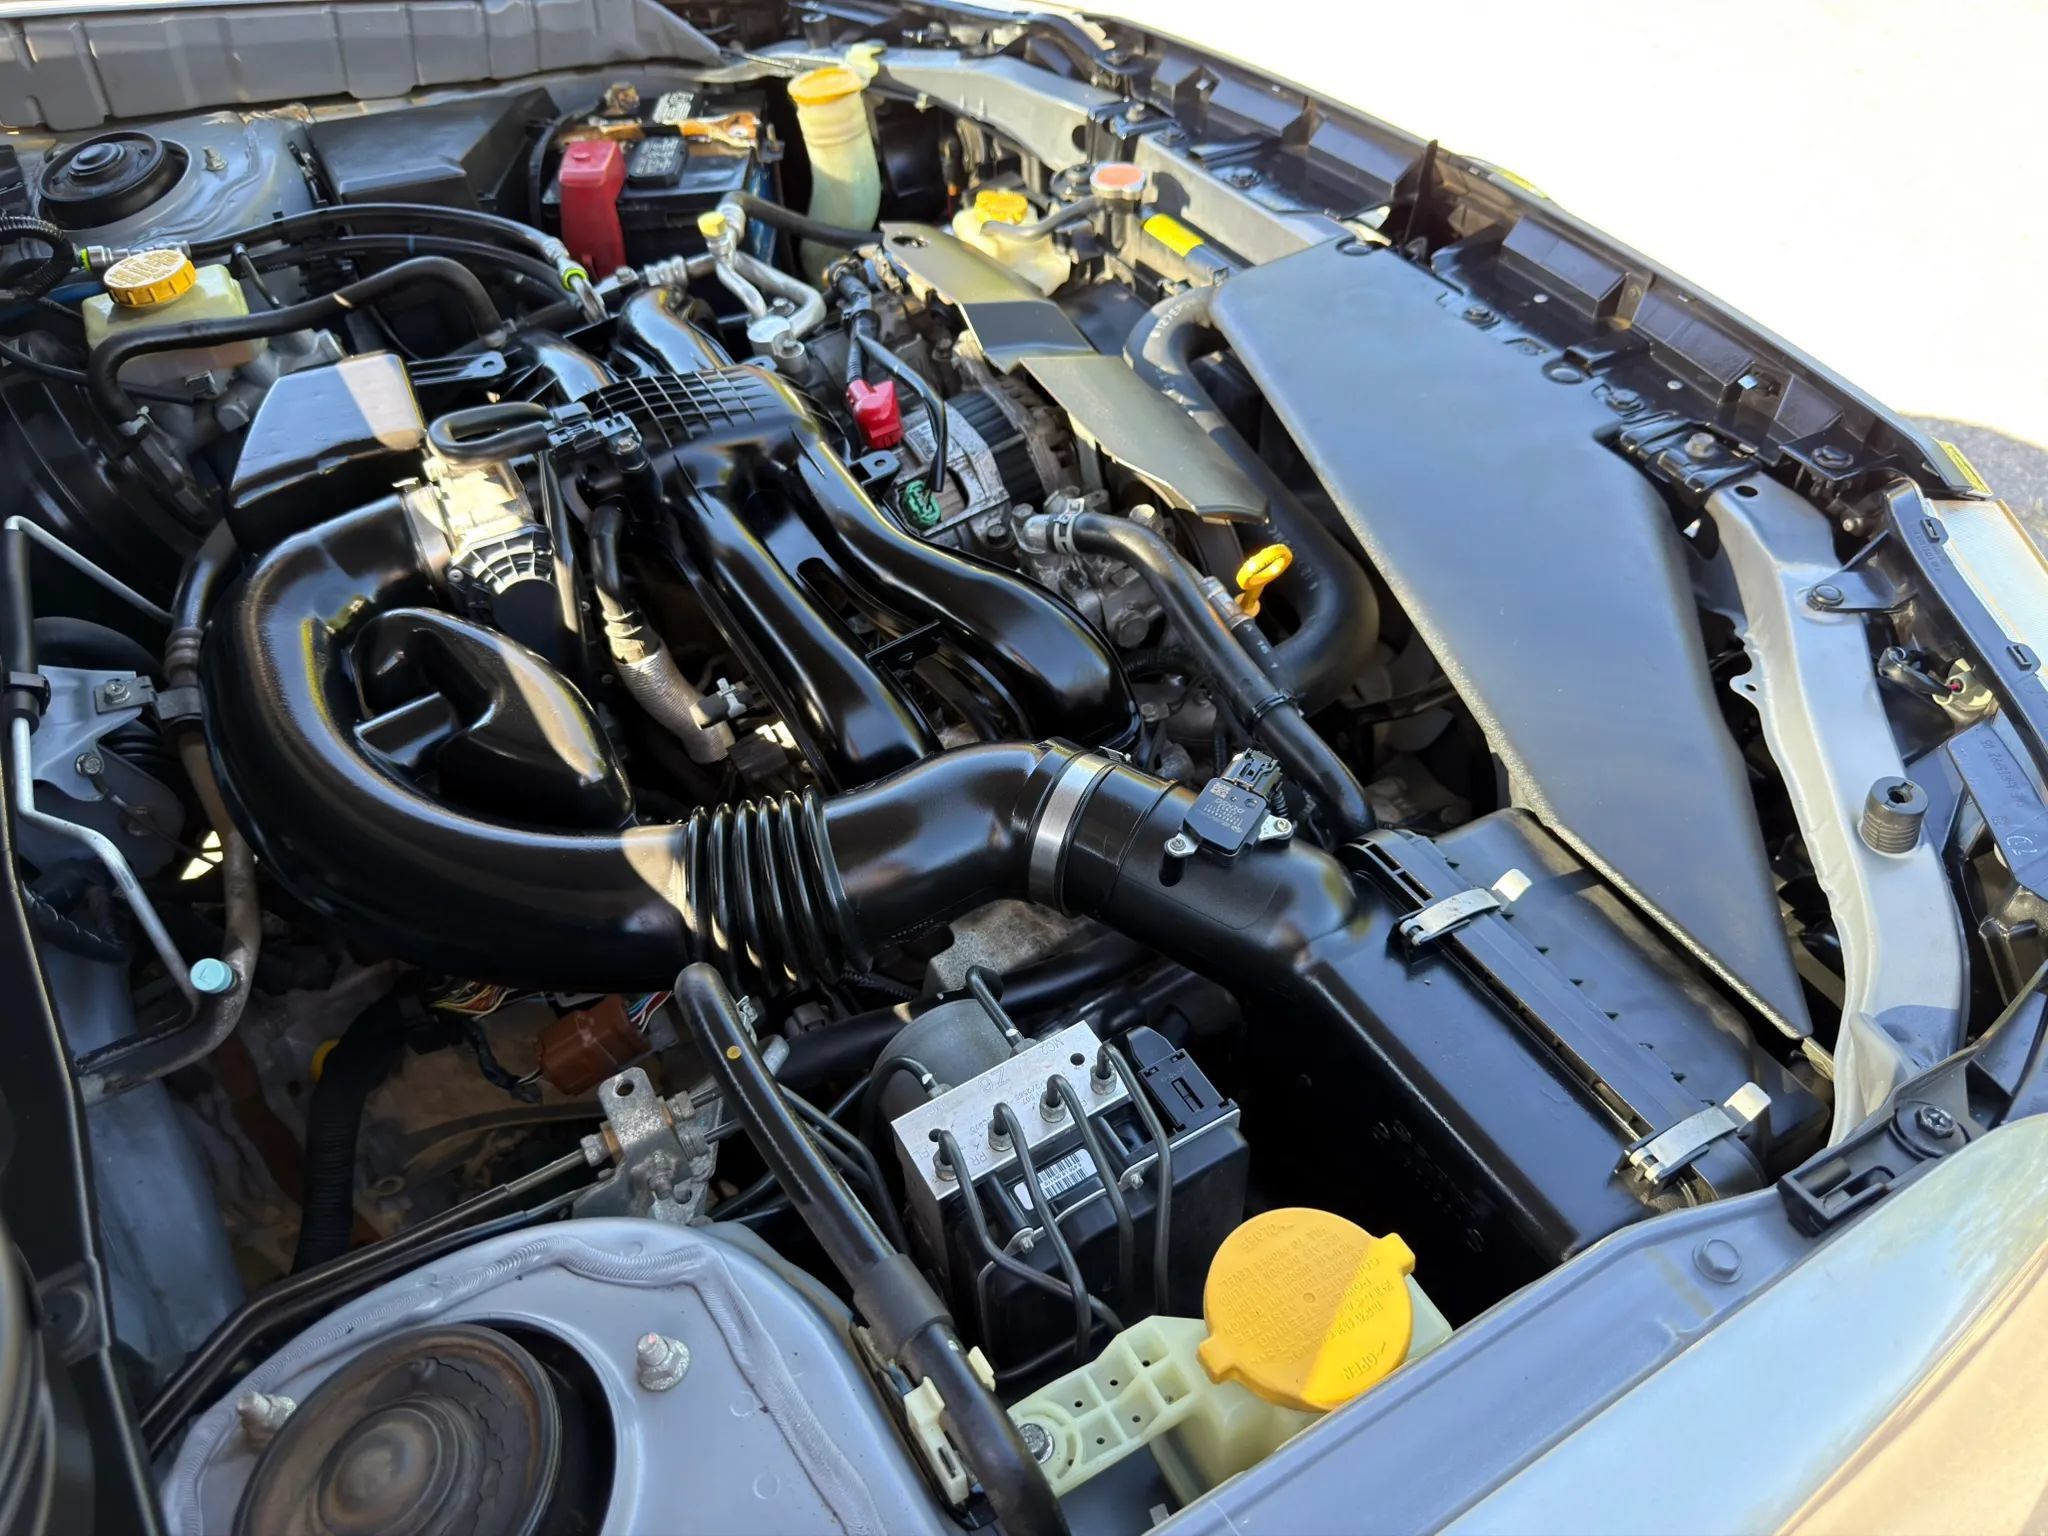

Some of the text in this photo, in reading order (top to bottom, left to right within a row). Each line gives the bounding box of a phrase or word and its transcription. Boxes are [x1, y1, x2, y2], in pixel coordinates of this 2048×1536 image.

[969, 1151, 986, 1166] RR
[1327, 1277, 1372, 1305] POWER
[1260, 1306, 1322, 1346] STEERING
[1342, 1352, 1378, 1379] OPEN
